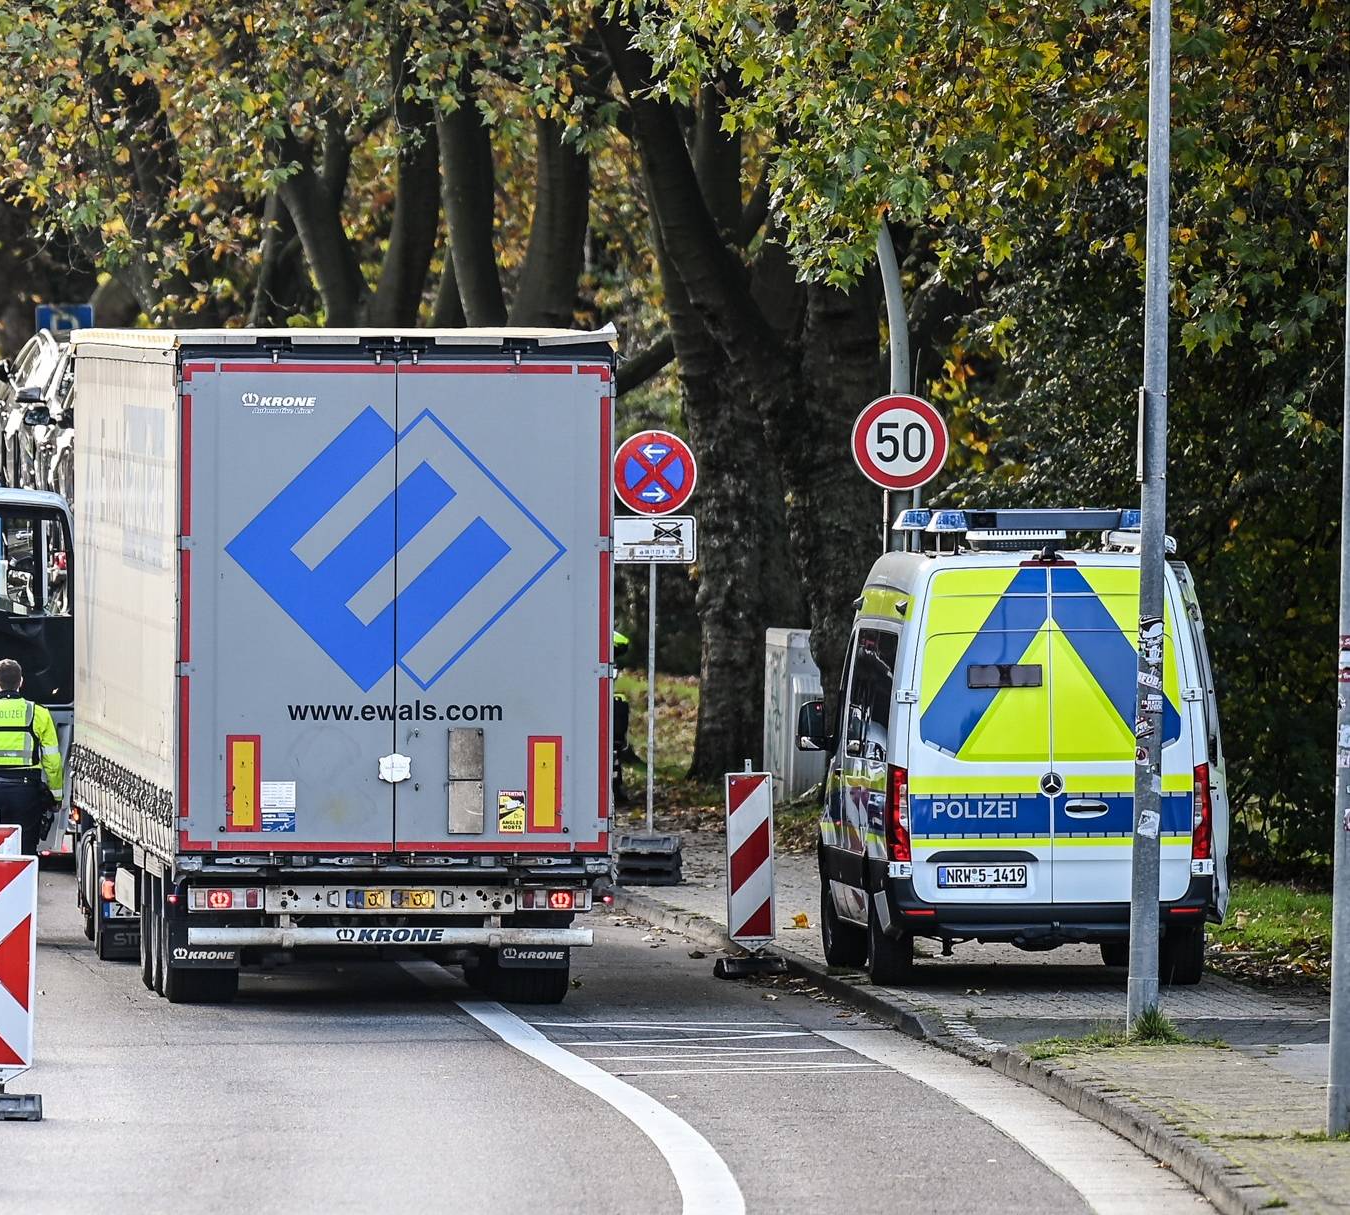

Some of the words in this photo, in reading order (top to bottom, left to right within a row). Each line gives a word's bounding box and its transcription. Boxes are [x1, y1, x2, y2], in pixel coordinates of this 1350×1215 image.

[259, 396, 317, 407] KRONE
[876, 422, 927, 463] 50
[288, 699, 503, 722] www.ewals.com
[932, 801, 1017, 819] POLIZEI
[947, 868, 971, 883] NRW
[978, 867, 1025, 883] 5-1419
[356, 928, 445, 942] KRONE
[188, 951, 235, 960] KRONE
[518, 951, 565, 960] KRONE
